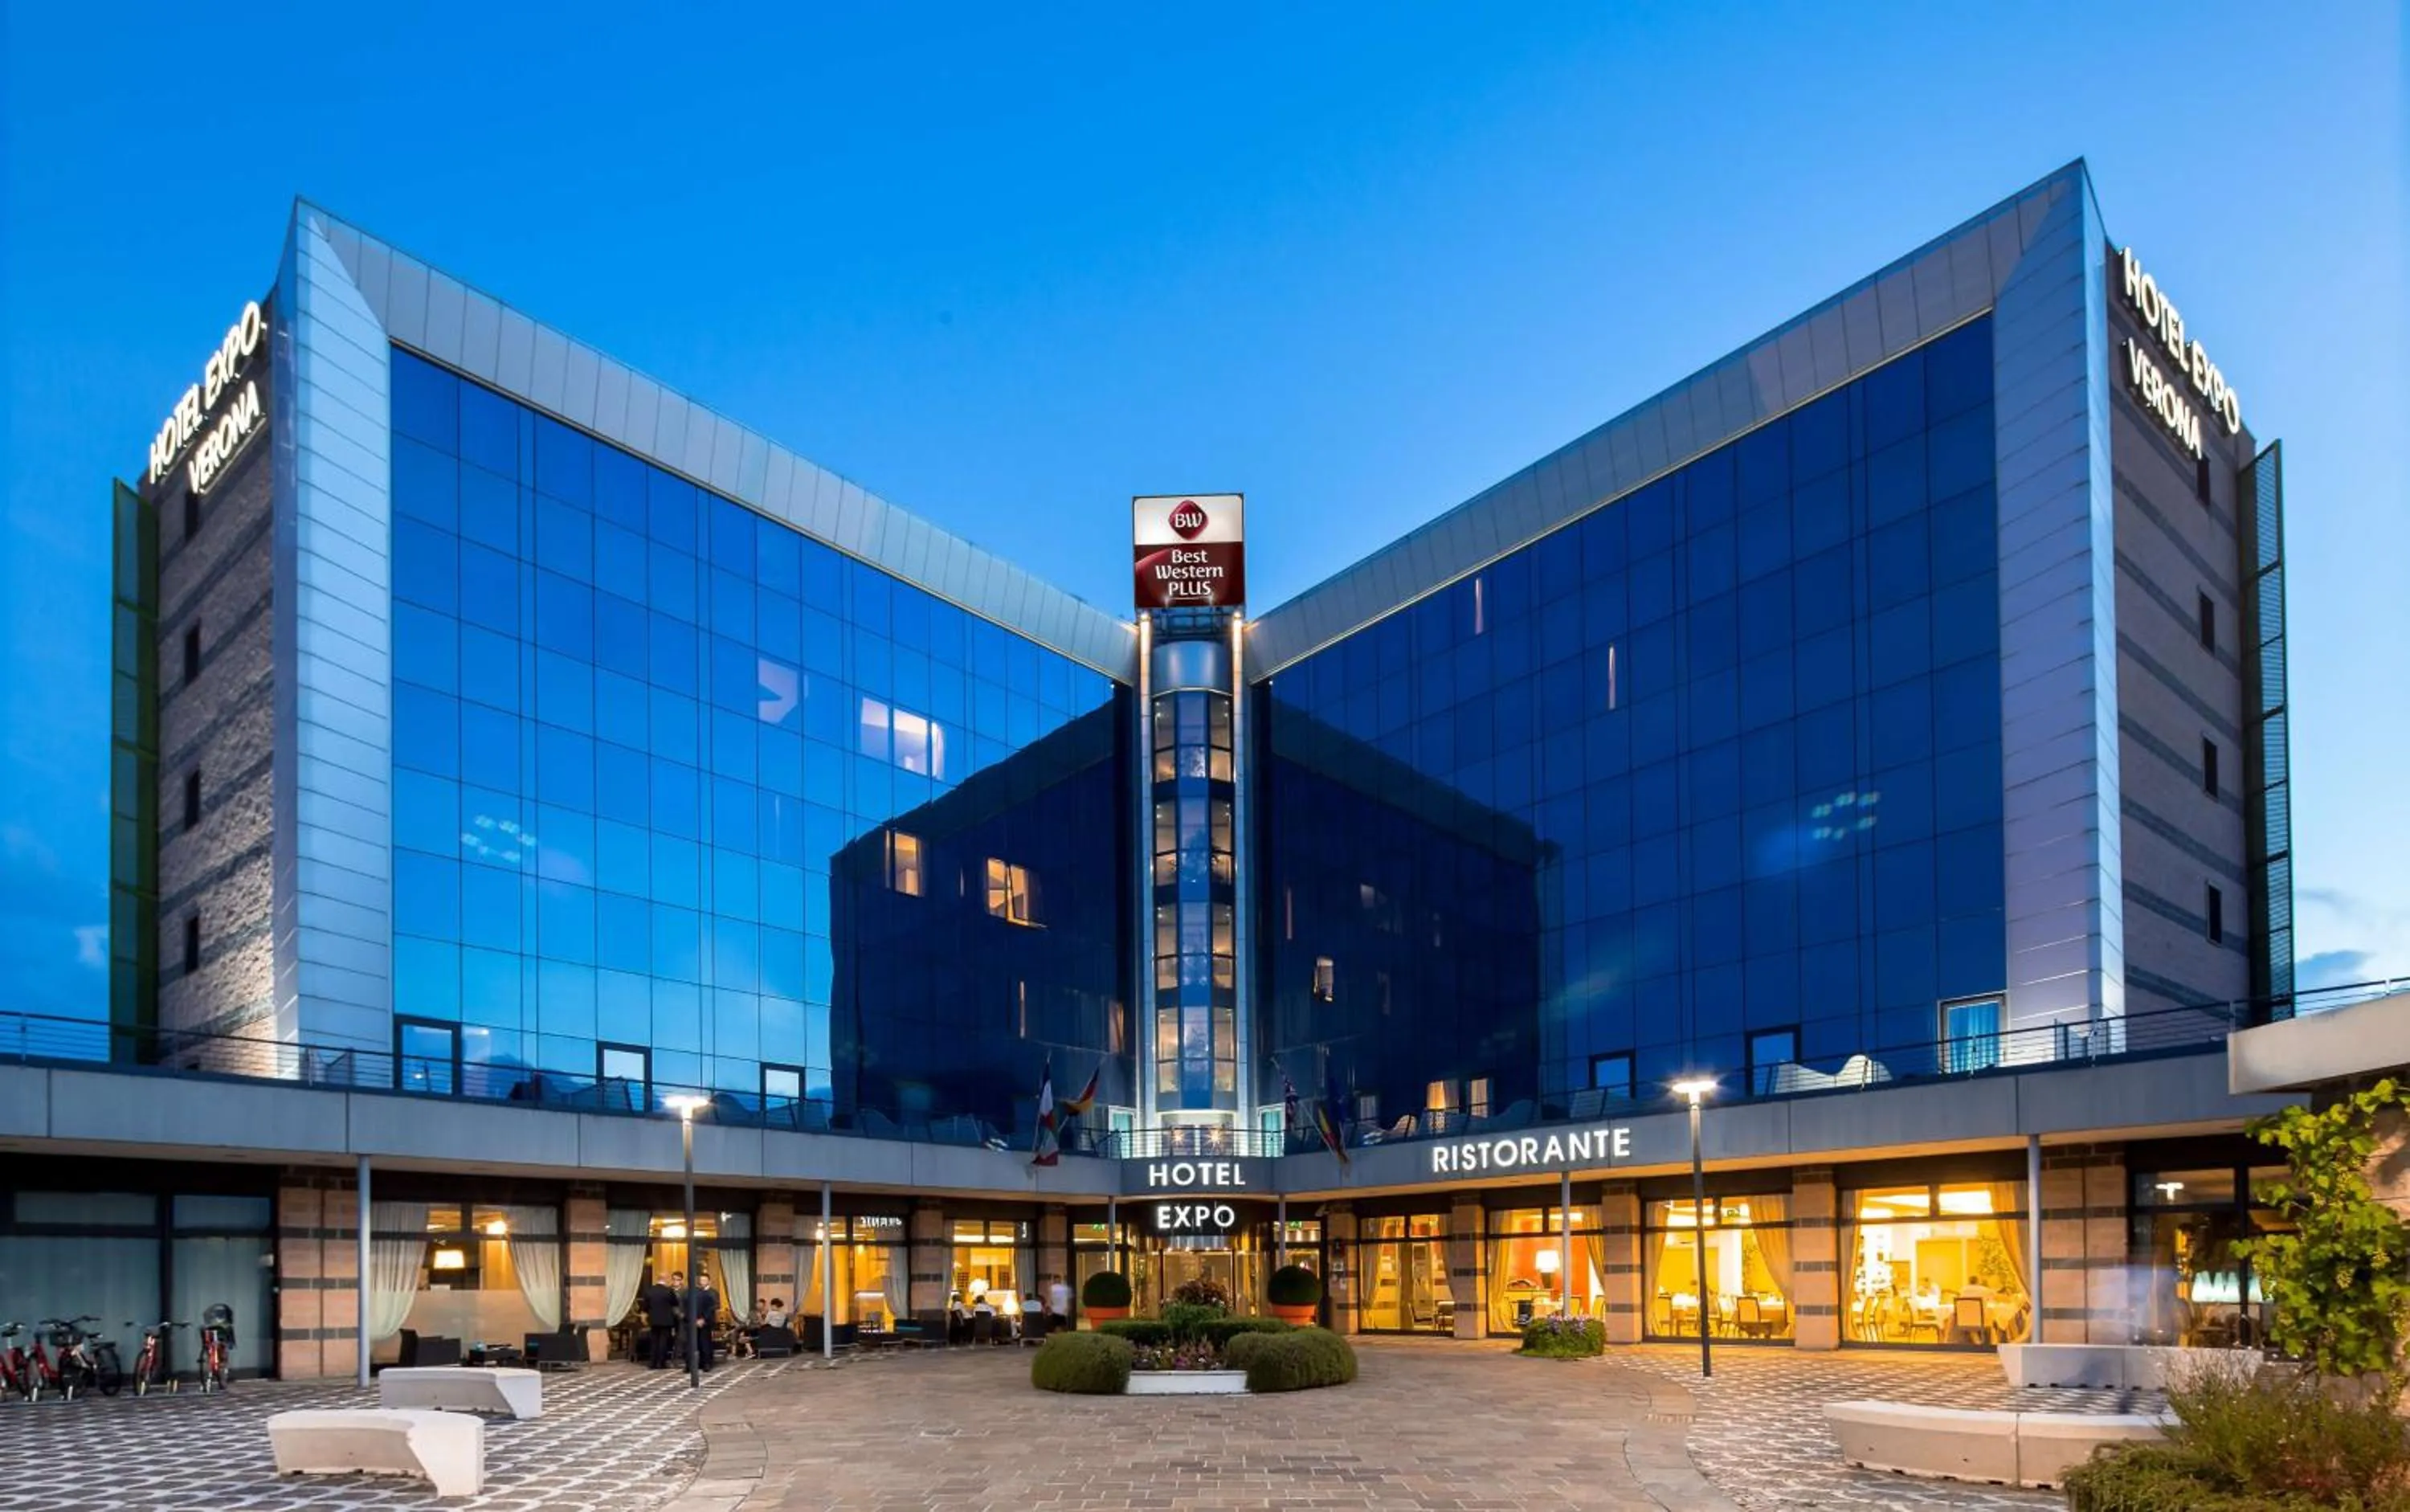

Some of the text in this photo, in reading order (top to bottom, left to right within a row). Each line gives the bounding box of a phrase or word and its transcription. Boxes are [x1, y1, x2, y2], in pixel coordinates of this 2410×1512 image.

[2124, 247, 2240, 435] HOTEL EXPO
[149, 300, 261, 484] HOTEL EXPO
[2128, 337, 2203, 460] VERONA
[187, 380, 260, 494] VERONA
[1174, 513, 1203, 528] BW
[1172, 549, 1208, 563] Best
[1155, 565, 1223, 579] Western
[1169, 581, 1211, 596] PLUS
[1432, 1128, 1631, 1173] RISTORANTE
[1149, 1163, 1246, 1187] HOTEL
[1157, 1205, 1235, 1228] EXPO
